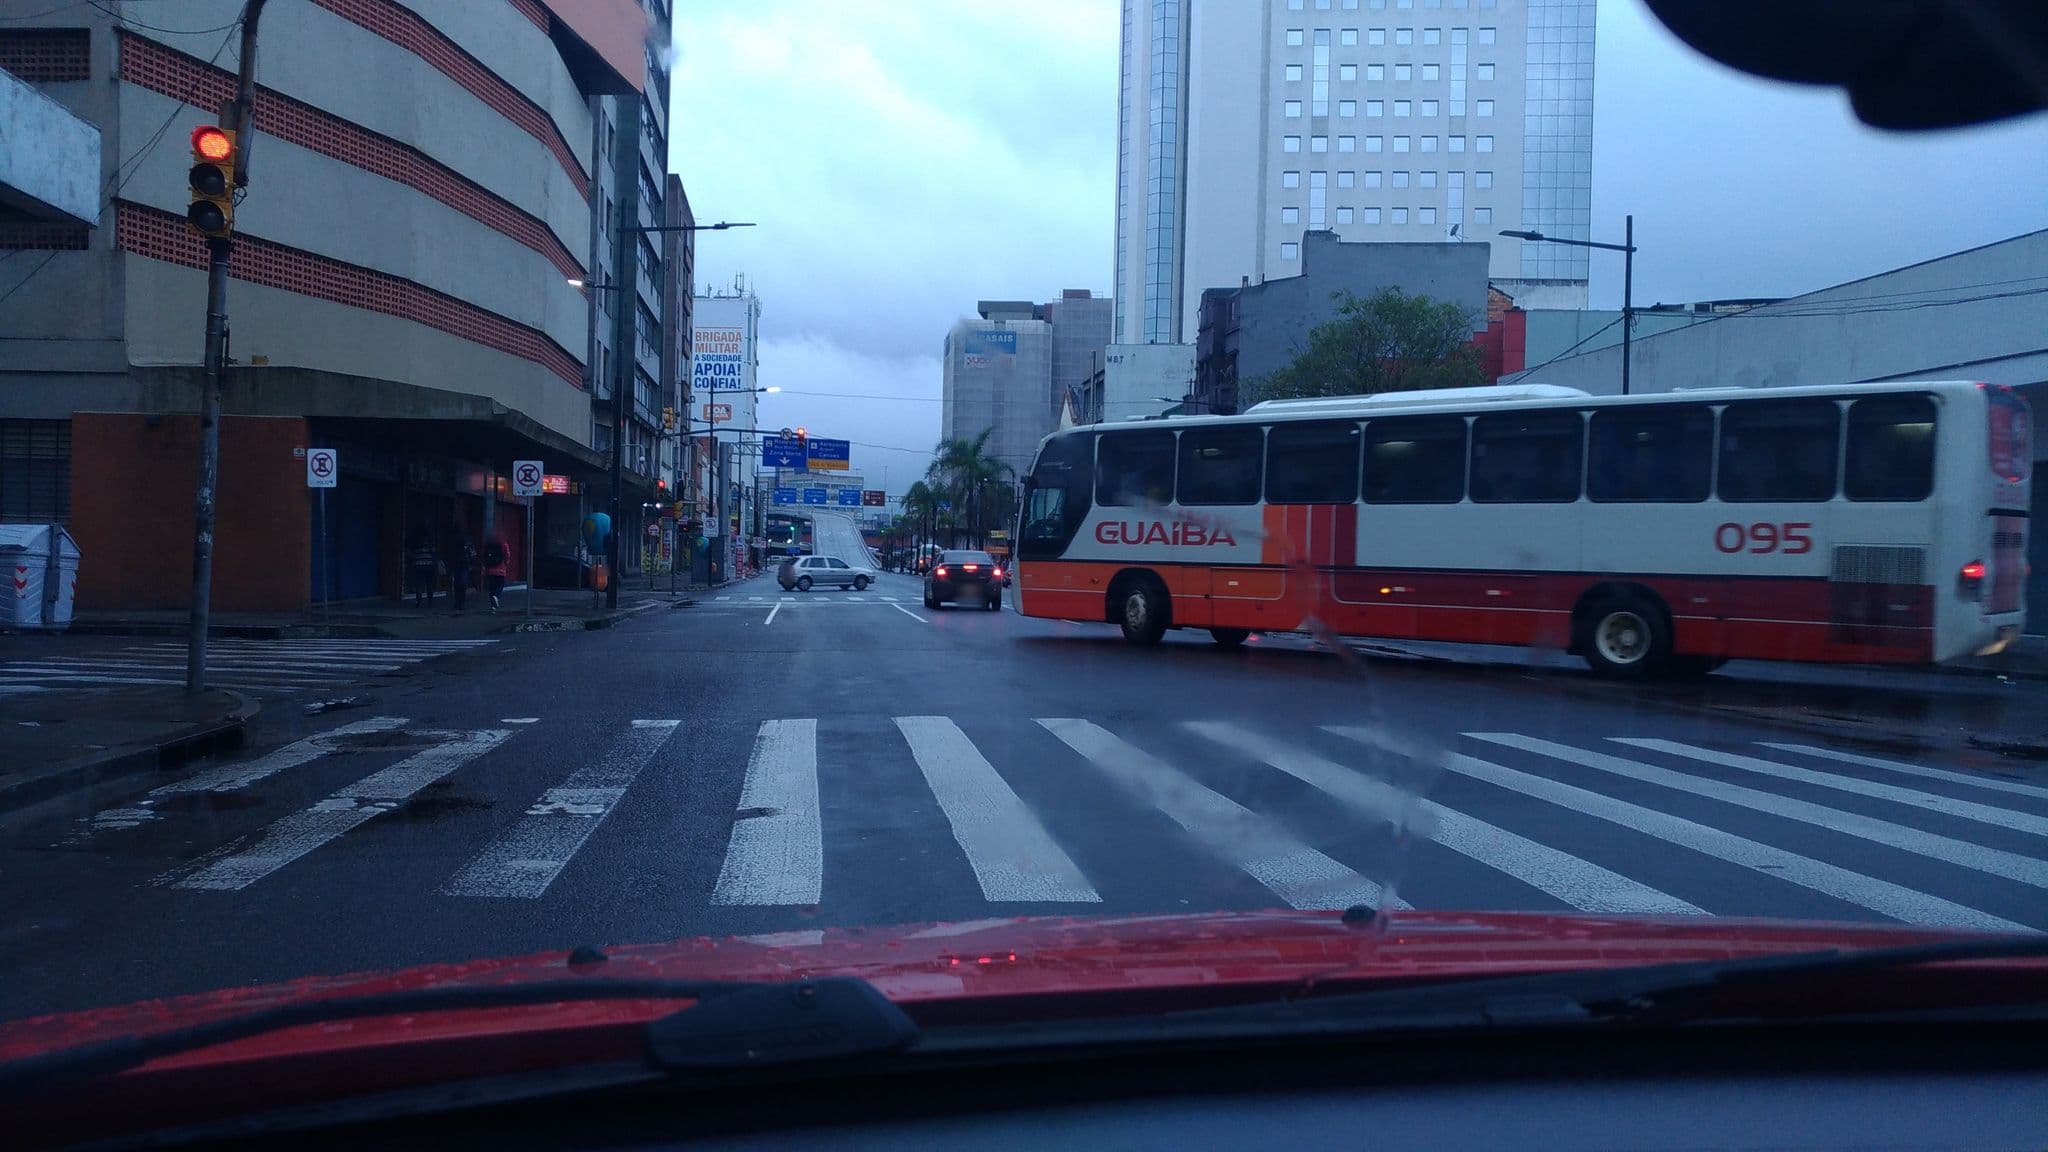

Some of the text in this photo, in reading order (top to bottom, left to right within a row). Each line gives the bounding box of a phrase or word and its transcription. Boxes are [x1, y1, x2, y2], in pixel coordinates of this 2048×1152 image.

[695, 331, 742, 342] BRIGADA
[695, 343, 742, 354] MILITAR.
[701, 354, 742, 362] SOCIEDADE
[694, 363, 741, 376] APOIA!
[694, 377, 741, 389] CONFIA!
[1714, 522, 1812, 554] 095
